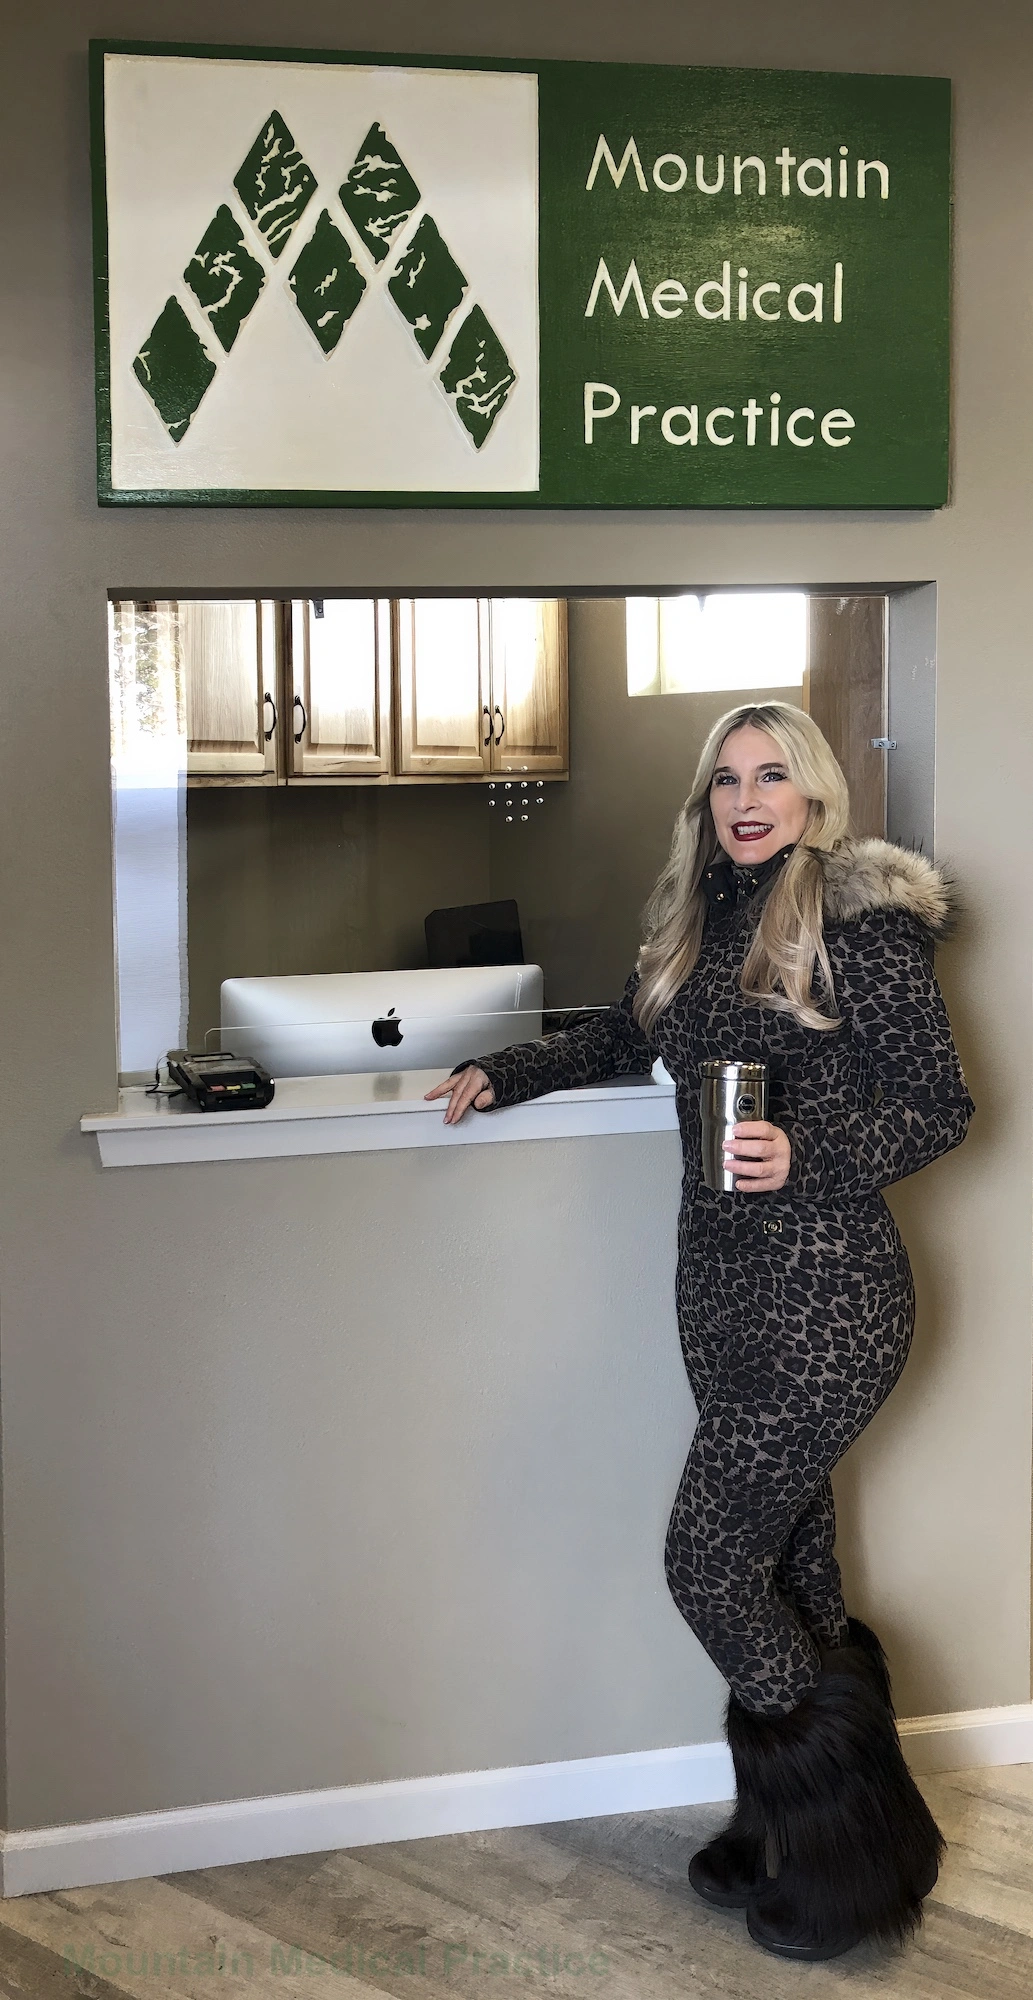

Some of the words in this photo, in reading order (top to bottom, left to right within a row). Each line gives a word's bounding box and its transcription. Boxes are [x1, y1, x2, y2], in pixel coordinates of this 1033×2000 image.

[585, 133, 890, 199] Mountain
[584, 256, 843, 324] Medical
[583, 381, 856, 447] Practice
